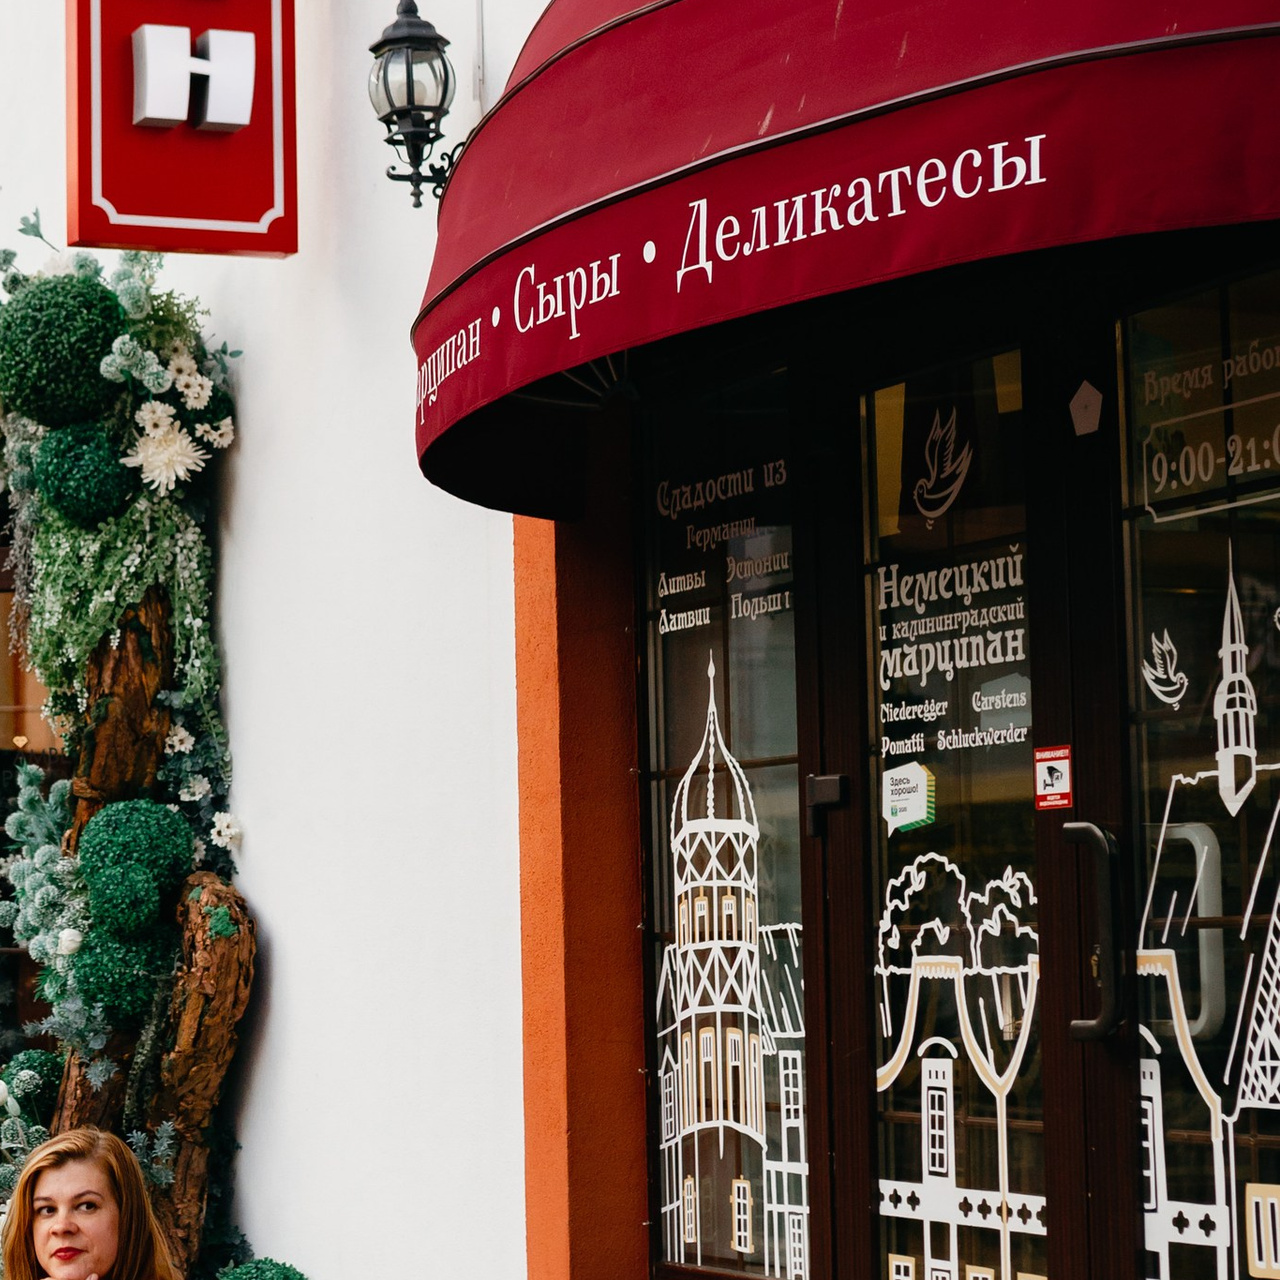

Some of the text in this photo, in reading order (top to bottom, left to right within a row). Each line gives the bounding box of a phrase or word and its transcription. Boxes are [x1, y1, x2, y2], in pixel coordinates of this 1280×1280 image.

[514, 252, 622, 341] Сыры
[676, 133, 1047, 294] Деликатесы
[1144, 338, 1280, 407] Время рабо
[657, 459, 787, 520] Сладости из
[658, 551, 790, 598] Литвы Эстонии
[878, 542, 1024, 614] Немецкий
[658, 607, 711, 635] Латвии
[879, 596, 1025, 641] и калининградский
[879, 628, 1026, 691] марципан
[880, 688, 1027, 723] Niederegger Carstens
[881, 723, 1027, 758] Pomatti Schluckwerder
[890, 776, 910, 787] Здесь
[890, 783, 919, 797] хорошо!
